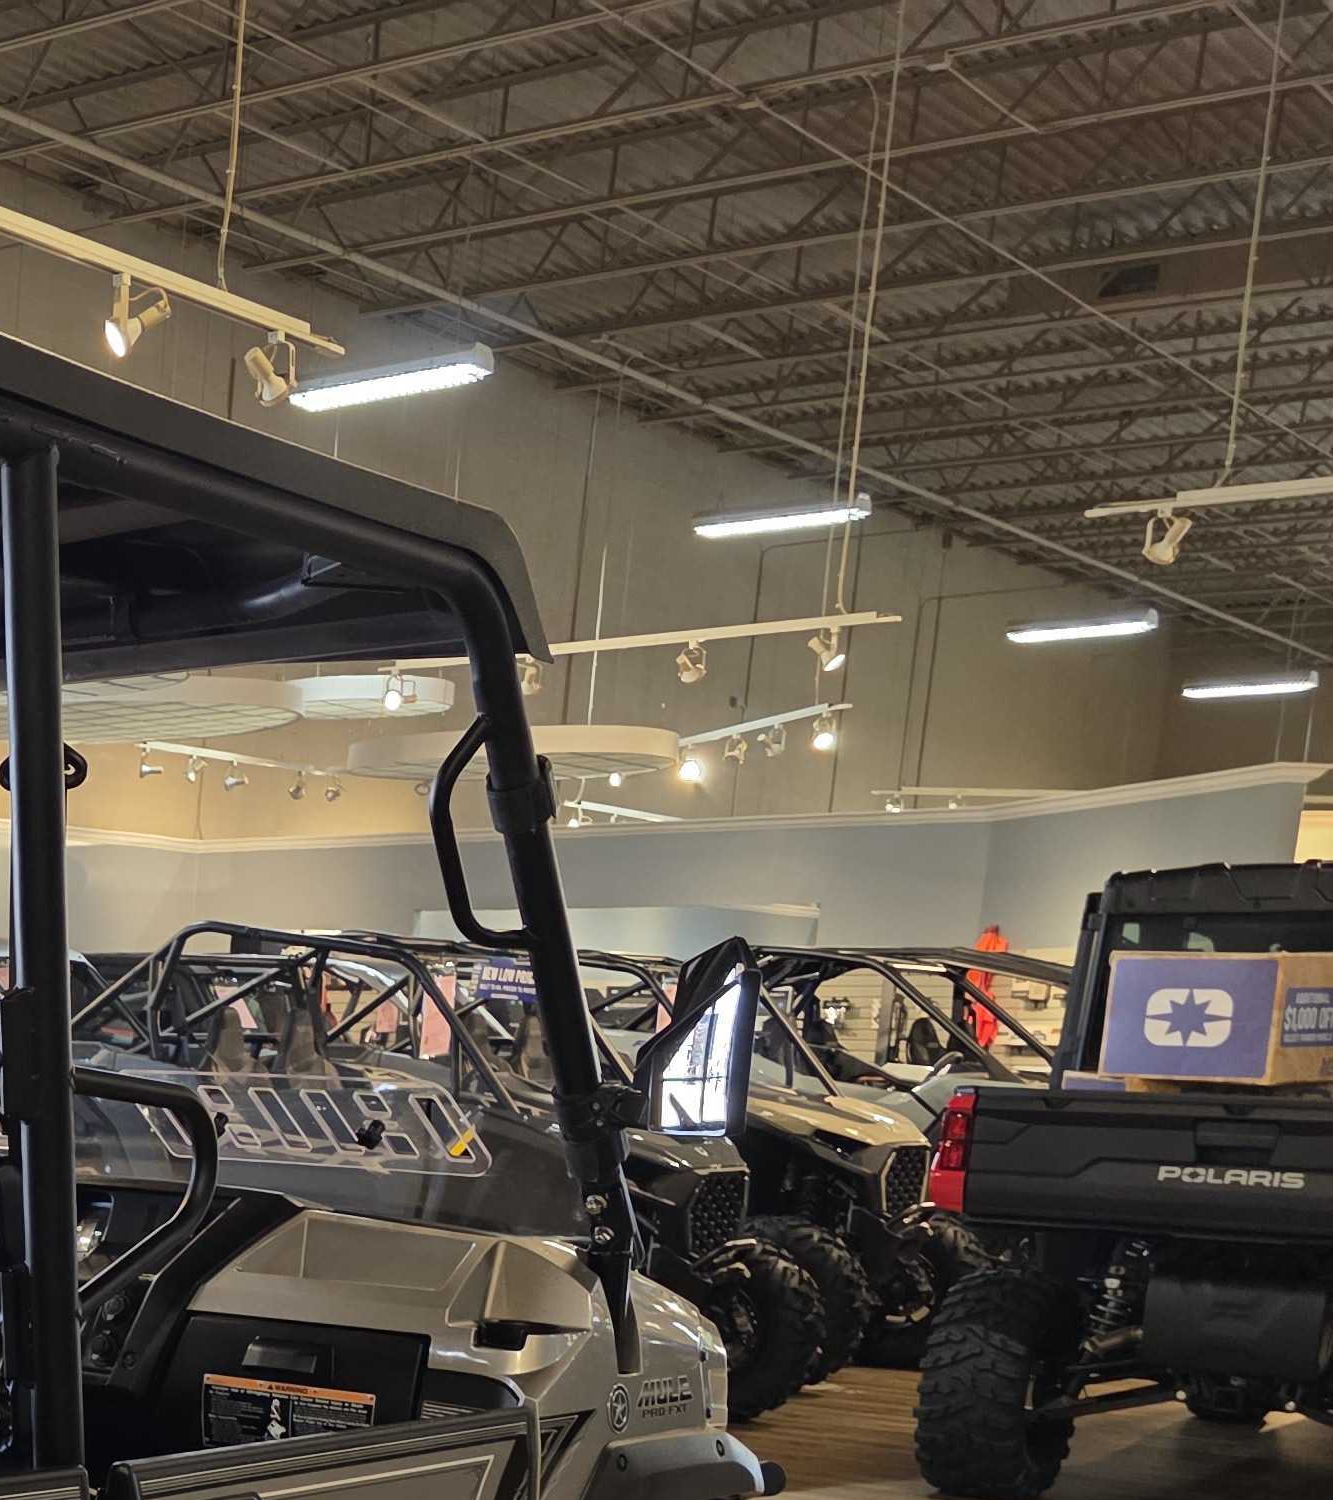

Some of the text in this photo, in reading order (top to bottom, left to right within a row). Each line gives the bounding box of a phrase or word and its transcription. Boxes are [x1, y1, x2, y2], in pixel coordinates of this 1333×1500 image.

[1156, 1166, 1306, 1190] POLARIS
[637, 1375, 694, 1407] MULE
[642, 1404, 688, 1418] PRO FXT
